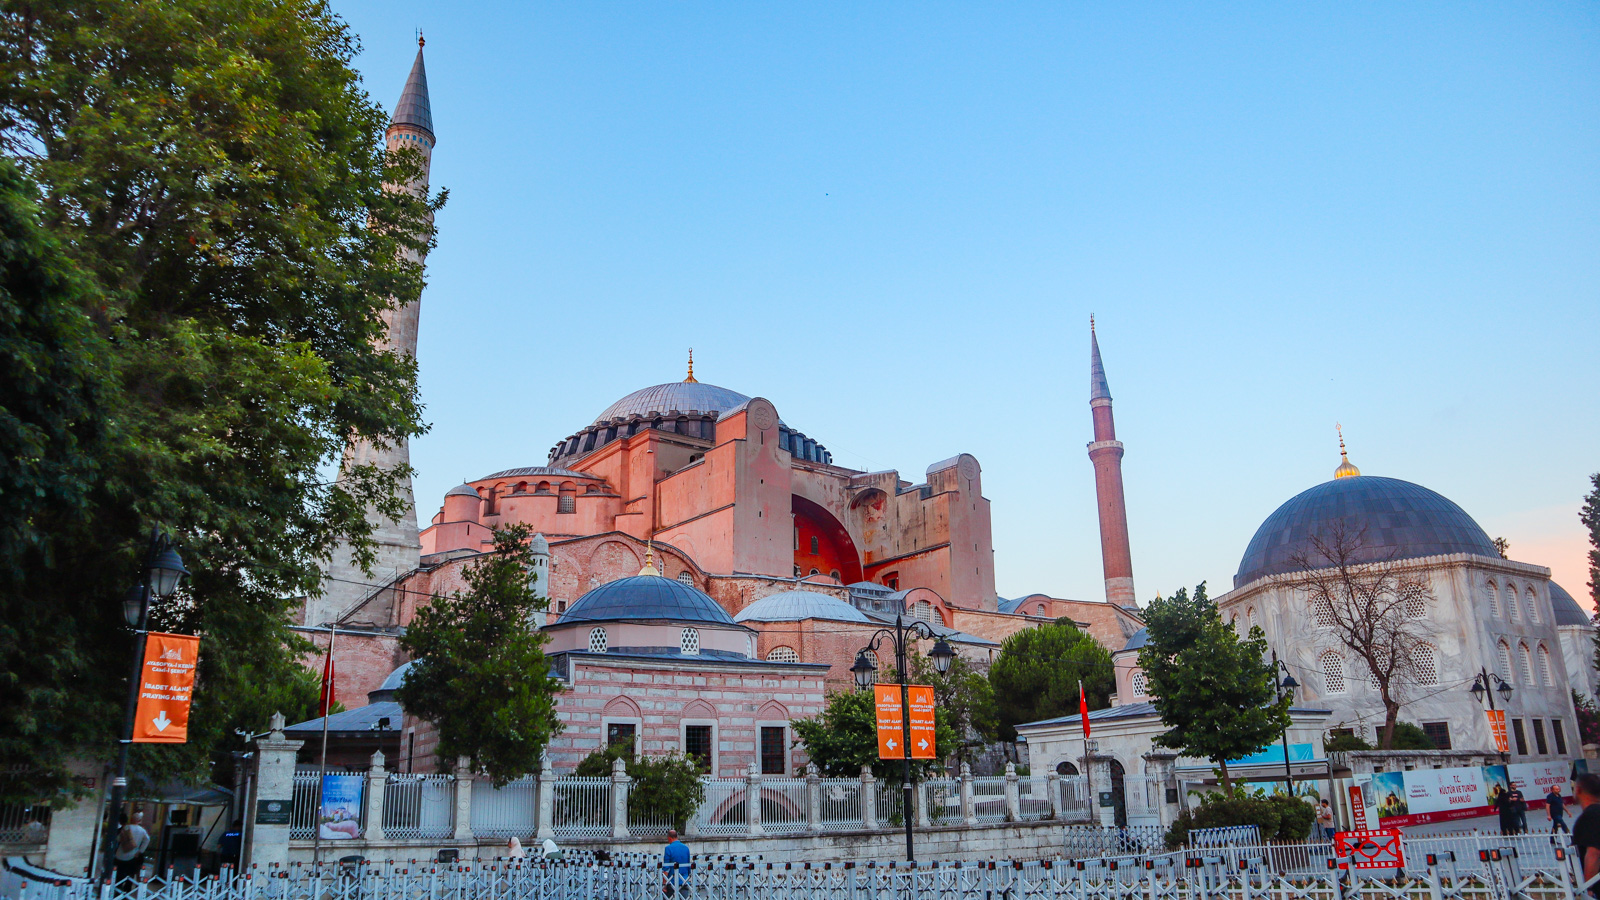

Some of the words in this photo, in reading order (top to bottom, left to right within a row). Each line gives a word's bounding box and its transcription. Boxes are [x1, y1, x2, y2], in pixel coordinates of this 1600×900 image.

[144, 682, 169, 690] İBADET
[142, 692, 170, 700] PRAYING
[1453, 775, 1461, 783] T.C.
[1534, 776, 1548, 786] KÜLTÜR
[1548, 777, 1553, 785] VE
[1552, 776, 1567, 784] TURİZM
[1439, 784, 1456, 795] KÜLTÜR
[1456, 785, 1462, 793] VE
[1461, 782, 1478, 793] TURİZM
[1449, 794, 1472, 804] BAKANLIĞI
